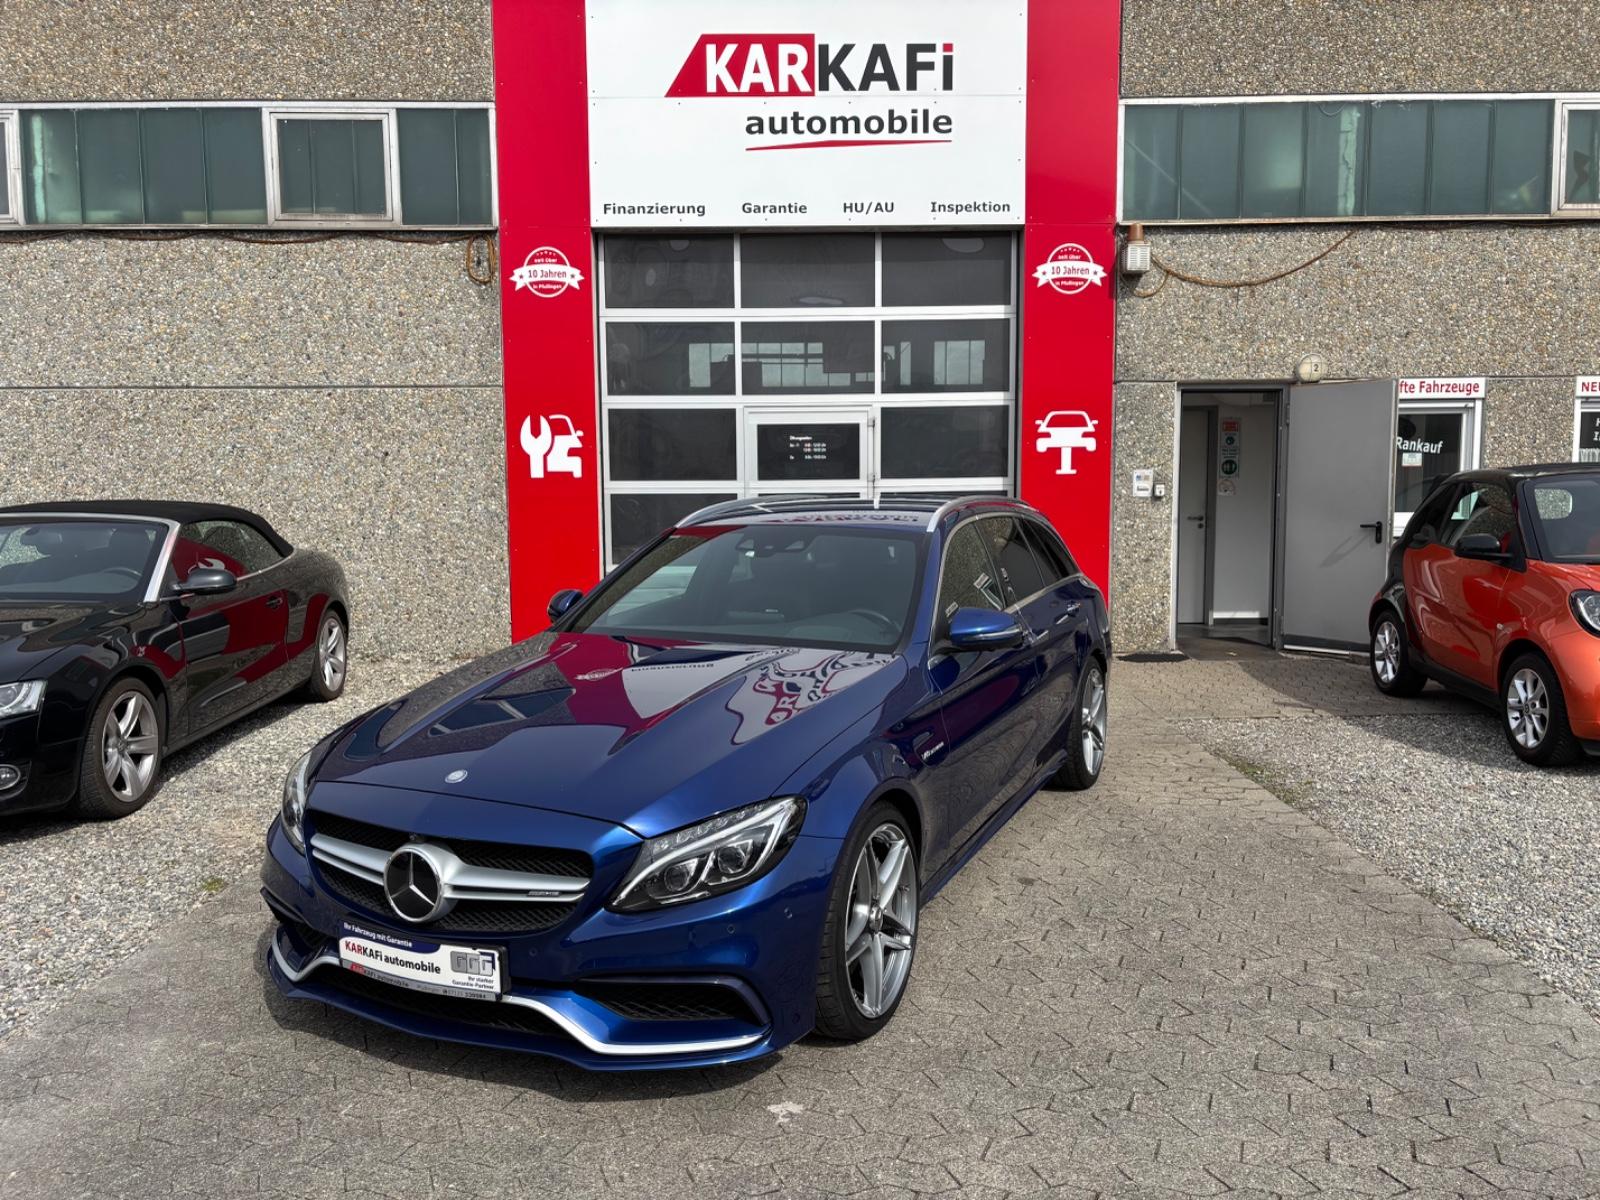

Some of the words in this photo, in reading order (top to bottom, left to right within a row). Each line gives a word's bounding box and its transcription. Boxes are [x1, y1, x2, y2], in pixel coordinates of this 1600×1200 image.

[705, 43, 954, 93] KARKAFi
[745, 109, 953, 135] automobile
[603, 202, 706, 217] Finanzierung
[742, 202, 808, 214] Garantie
[843, 201, 895, 214] HU/AU
[930, 201, 1011, 214] Inspektion
[528, 269, 538, 279] 10
[540, 269, 567, 279] Jahren
[1051, 266, 1061, 275] 10
[1063, 265, 1090, 276] Jahren
[1313, 363, 1320, 373] 2
[1418, 380, 1480, 396] Fahrzeuge
[1581, 382, 1600, 392] NE
[352, 925, 376, 940] Fahrzeug
[386, 935, 413, 948] Garantie
[345, 940, 383, 962] KARKAFi
[384, 955, 442, 975] automobile
